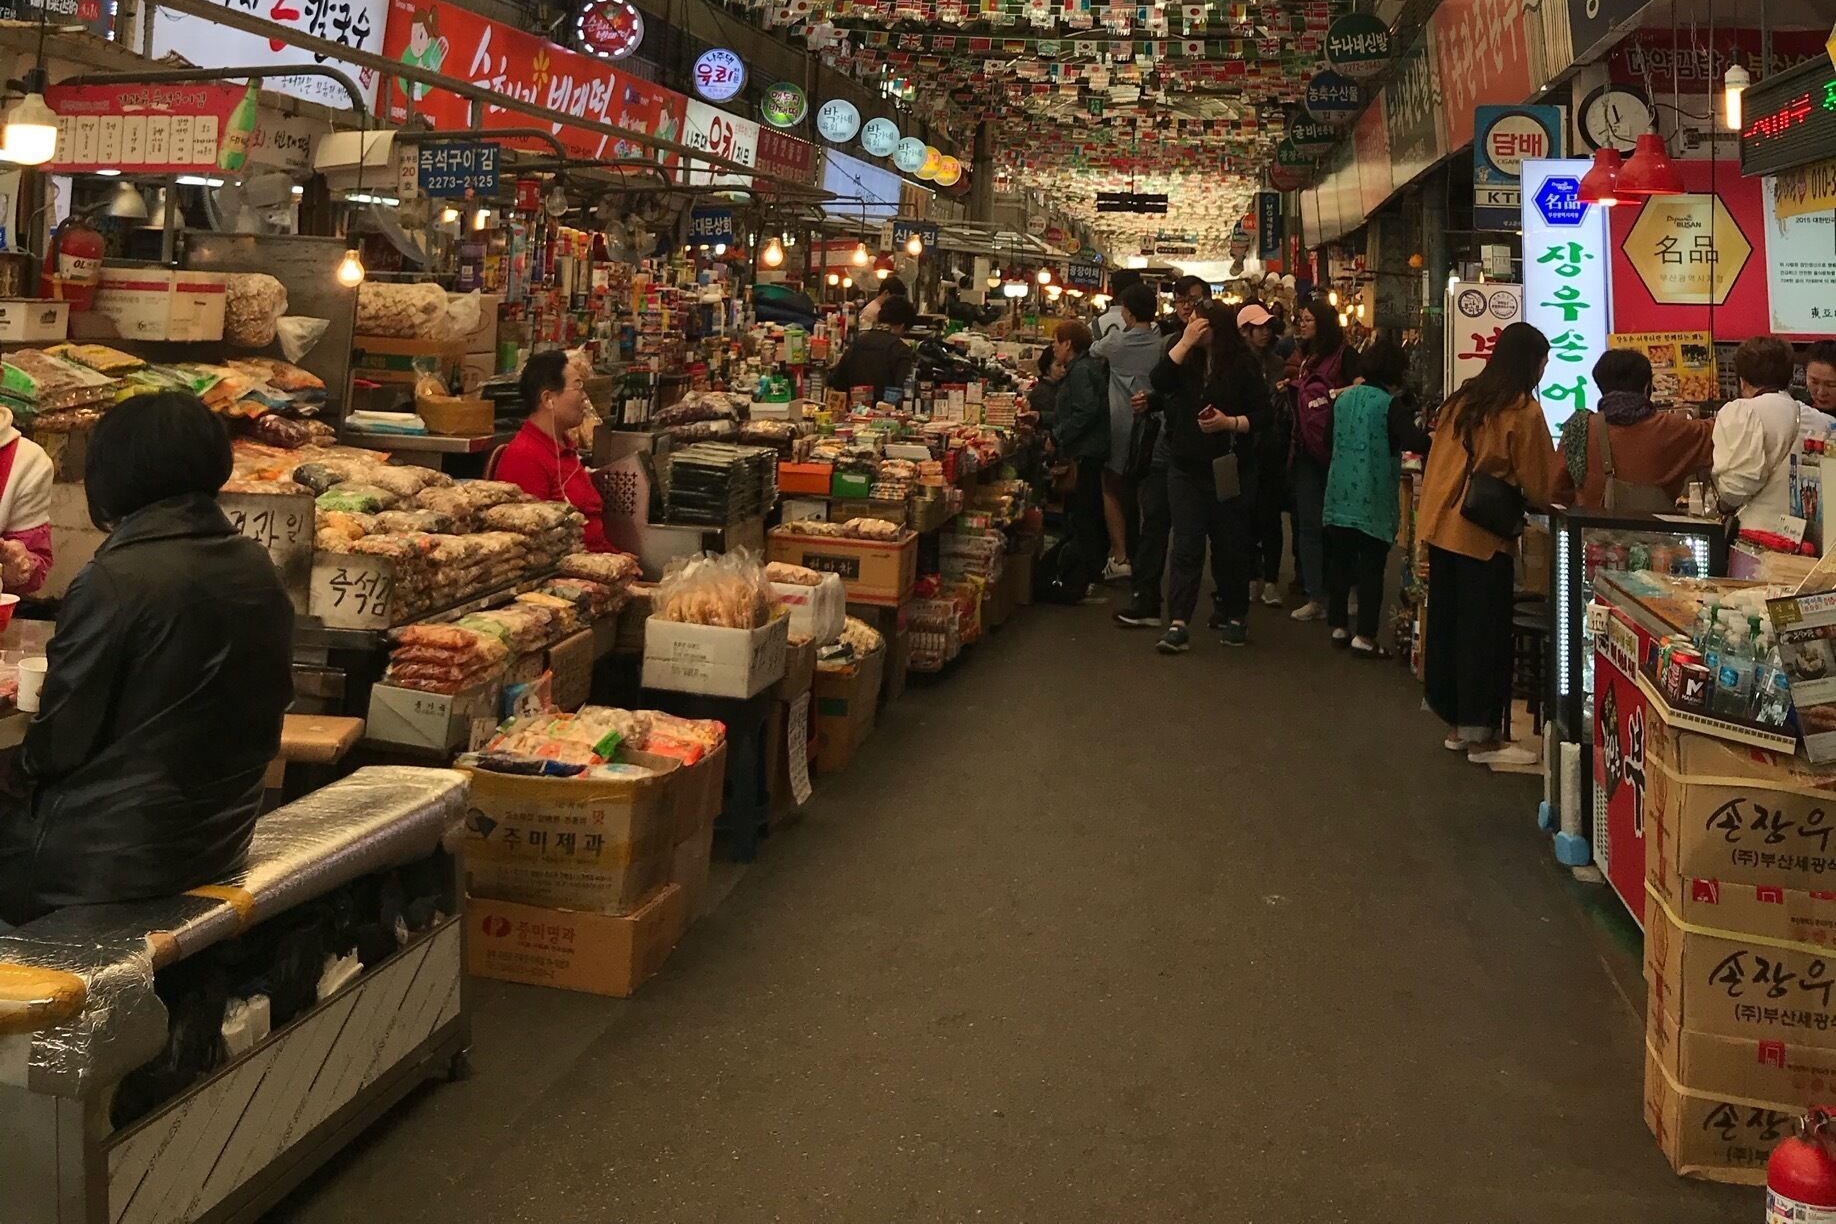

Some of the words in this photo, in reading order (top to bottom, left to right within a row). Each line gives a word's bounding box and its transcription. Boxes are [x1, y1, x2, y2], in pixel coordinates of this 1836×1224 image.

[1329, 32, 1389, 56] 누나네신발
[706, 51, 735, 66] 나주댁
[823, 106, 853, 124] 박가네
[1492, 132, 1542, 157] 담배
[402, 166, 416, 177] 20
[420, 149, 475, 172] 즉석구이
[1654, 234, 1719, 265] 名品
[329, 567, 391, 617] 즉석김
[1705, 797, 1835, 852] 손장우
[503, 827, 606, 857] 주미제과
[1708, 949, 1836, 1007] 손장우
